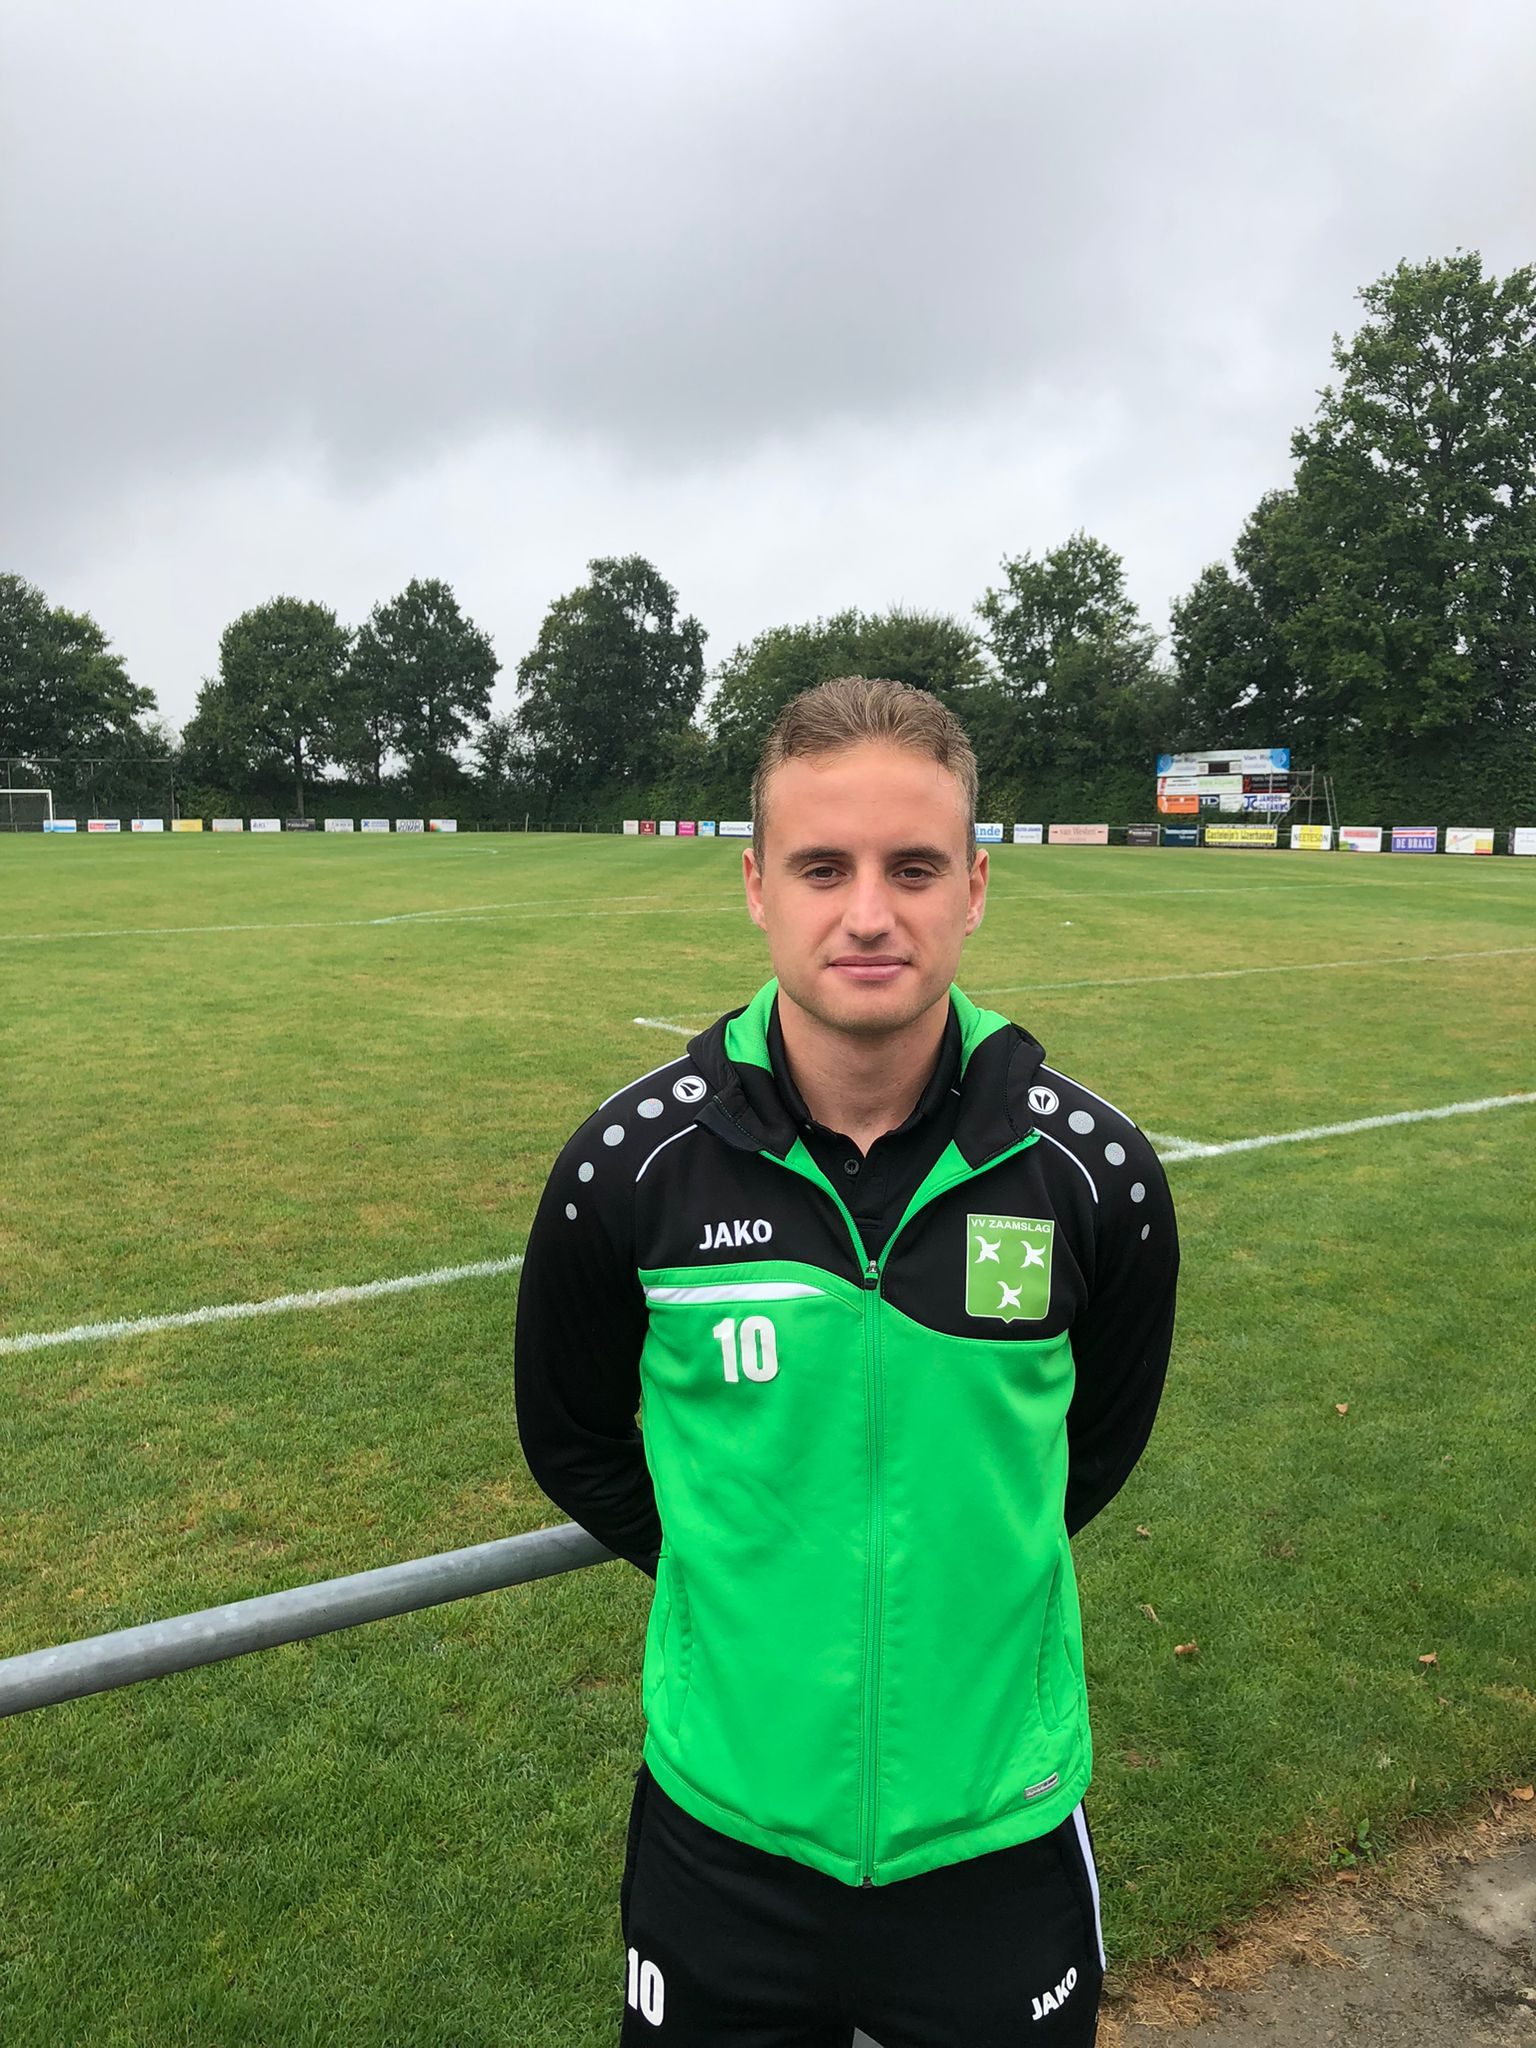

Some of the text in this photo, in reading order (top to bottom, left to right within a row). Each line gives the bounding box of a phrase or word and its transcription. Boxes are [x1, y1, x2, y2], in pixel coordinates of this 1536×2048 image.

[976, 826, 1001, 836] inde
[699, 1218, 773, 1250] JAKO
[970, 1218, 1051, 1234] VV ZAAMSLAG
[712, 1315, 779, 1384] 10
[627, 1946, 665, 2028] 10
[1030, 1966, 1078, 2022] JAKO
